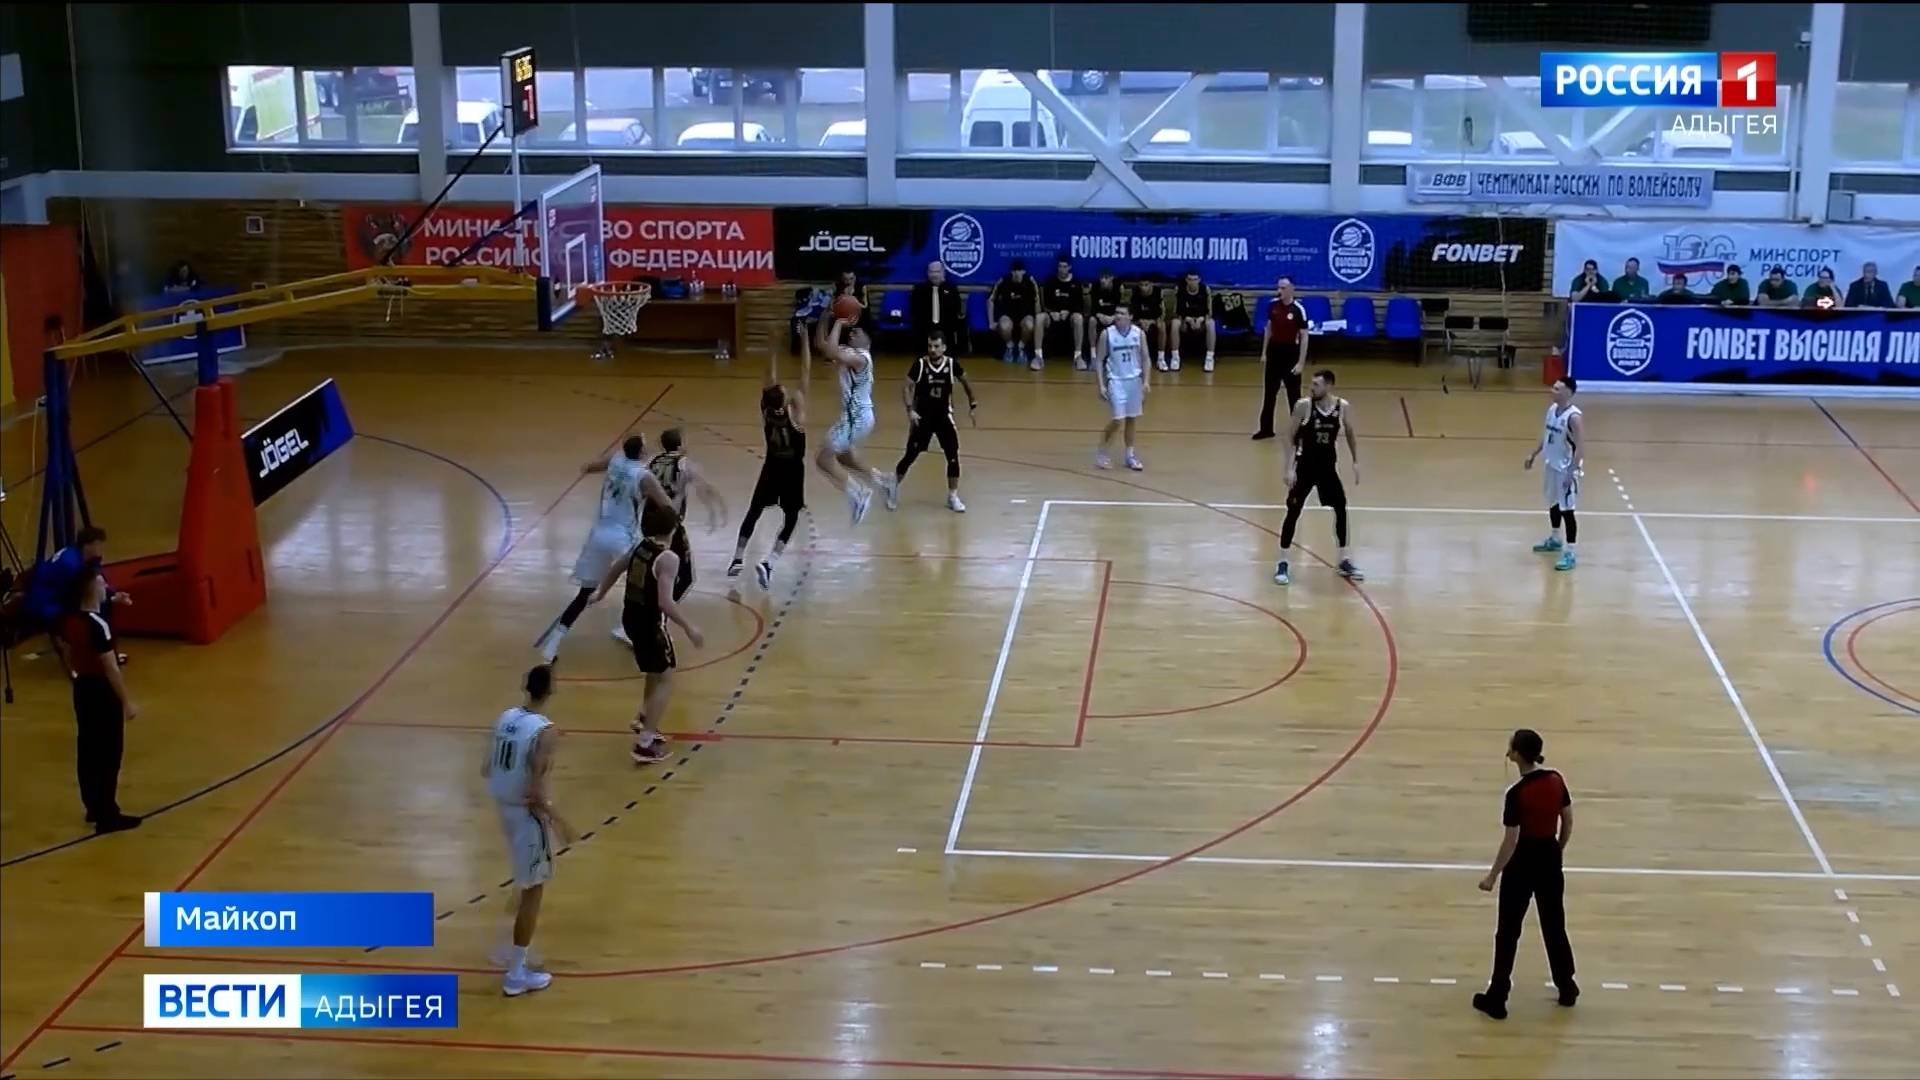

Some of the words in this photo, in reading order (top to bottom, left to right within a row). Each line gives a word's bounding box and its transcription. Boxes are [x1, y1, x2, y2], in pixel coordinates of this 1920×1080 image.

[1432, 173, 1468, 187] ВФВ
[1478, 173, 1549, 195] ЧЕМПИОНАТ
[1553, 174, 1600, 196] РОССИИ
[1607, 176, 1623, 196] ПО
[1628, 173, 1704, 198] ВОЛЕЙБОЛУ
[640, 220, 745, 241] СПОРТА
[798, 230, 886, 252] JÖGEL
[1070, 235, 1128, 259] FONBET
[1130, 236, 1204, 260] ВЫСШАЯ
[1207, 237, 1249, 261] ЛИГА
[1431, 243, 1524, 263] FONBET
[1749, 247, 1842, 263] МИНСПОРТ
[609, 248, 774, 272] ФЕДЕРАЦИИ
[1686, 327, 1770, 361] FONBET
[1773, 328, 1882, 363] ВЫСШАЯ
[259, 428, 310, 479] JÖGEL
